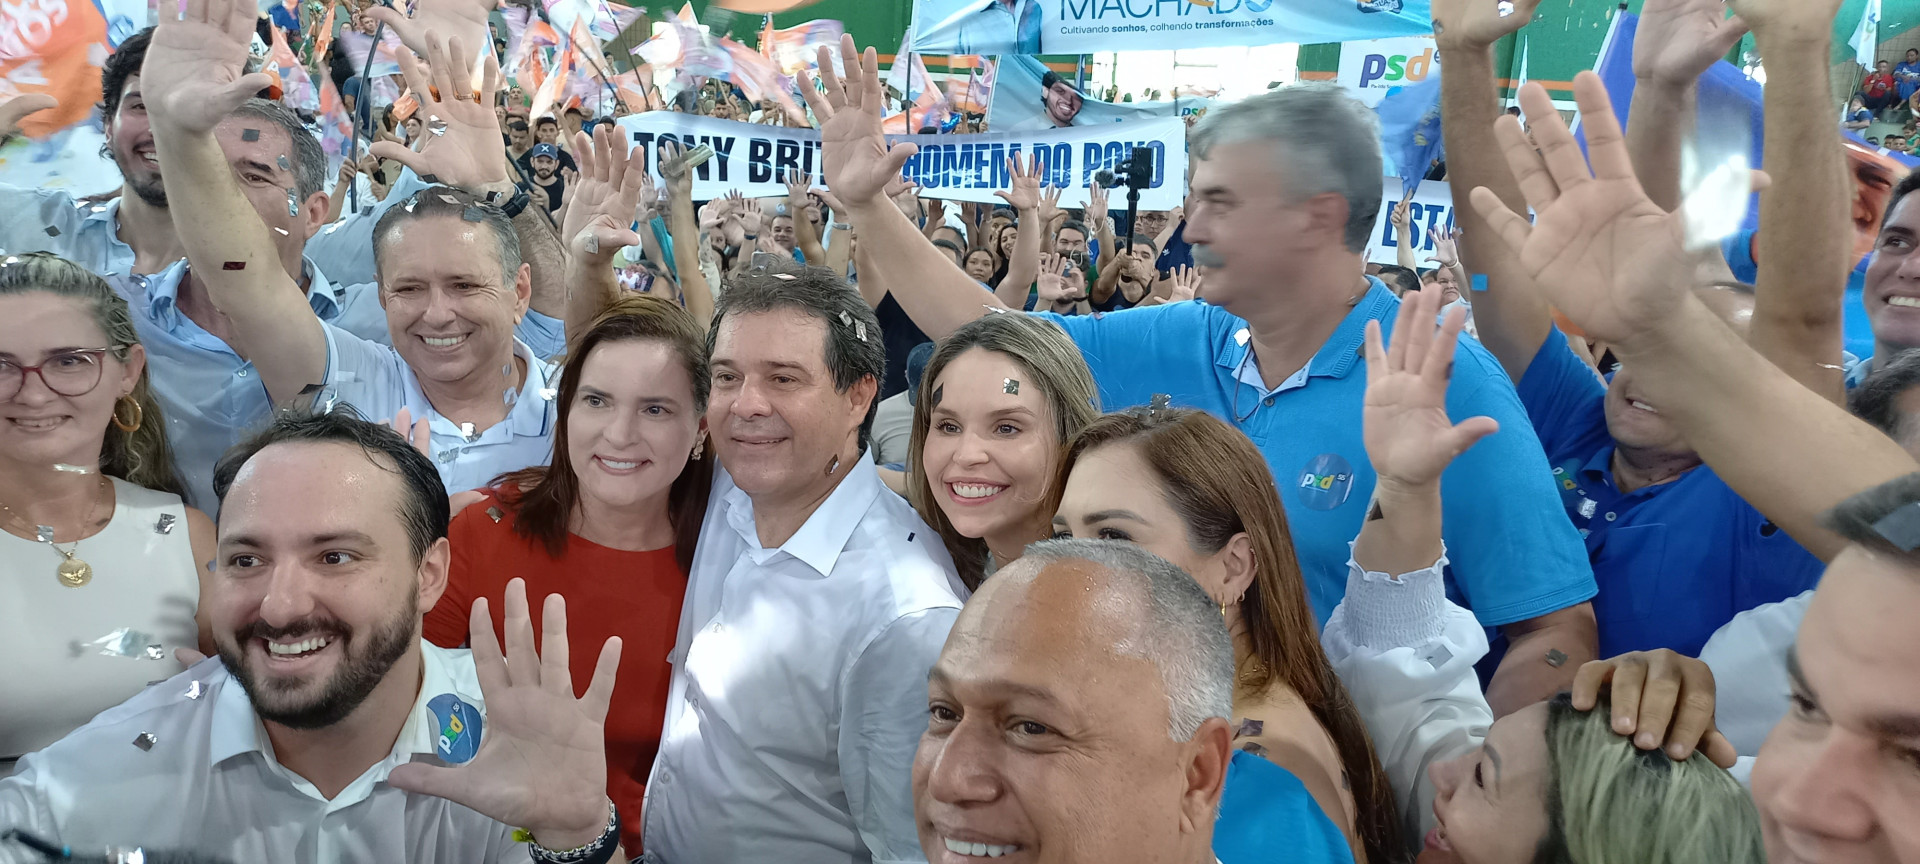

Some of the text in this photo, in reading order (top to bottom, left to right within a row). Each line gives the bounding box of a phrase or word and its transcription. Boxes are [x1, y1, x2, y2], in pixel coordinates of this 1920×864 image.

[1060, 18, 1274, 34] Cultivando sonhos, colhendo transformações
[1359, 48, 1433, 88] psd
[634, 131, 736, 182] TONY
[902, 142, 1022, 189] HOMEM
[1033, 141, 1073, 189] DO
[1301, 473, 1335, 490] psd
[439, 713, 464, 755] psd
